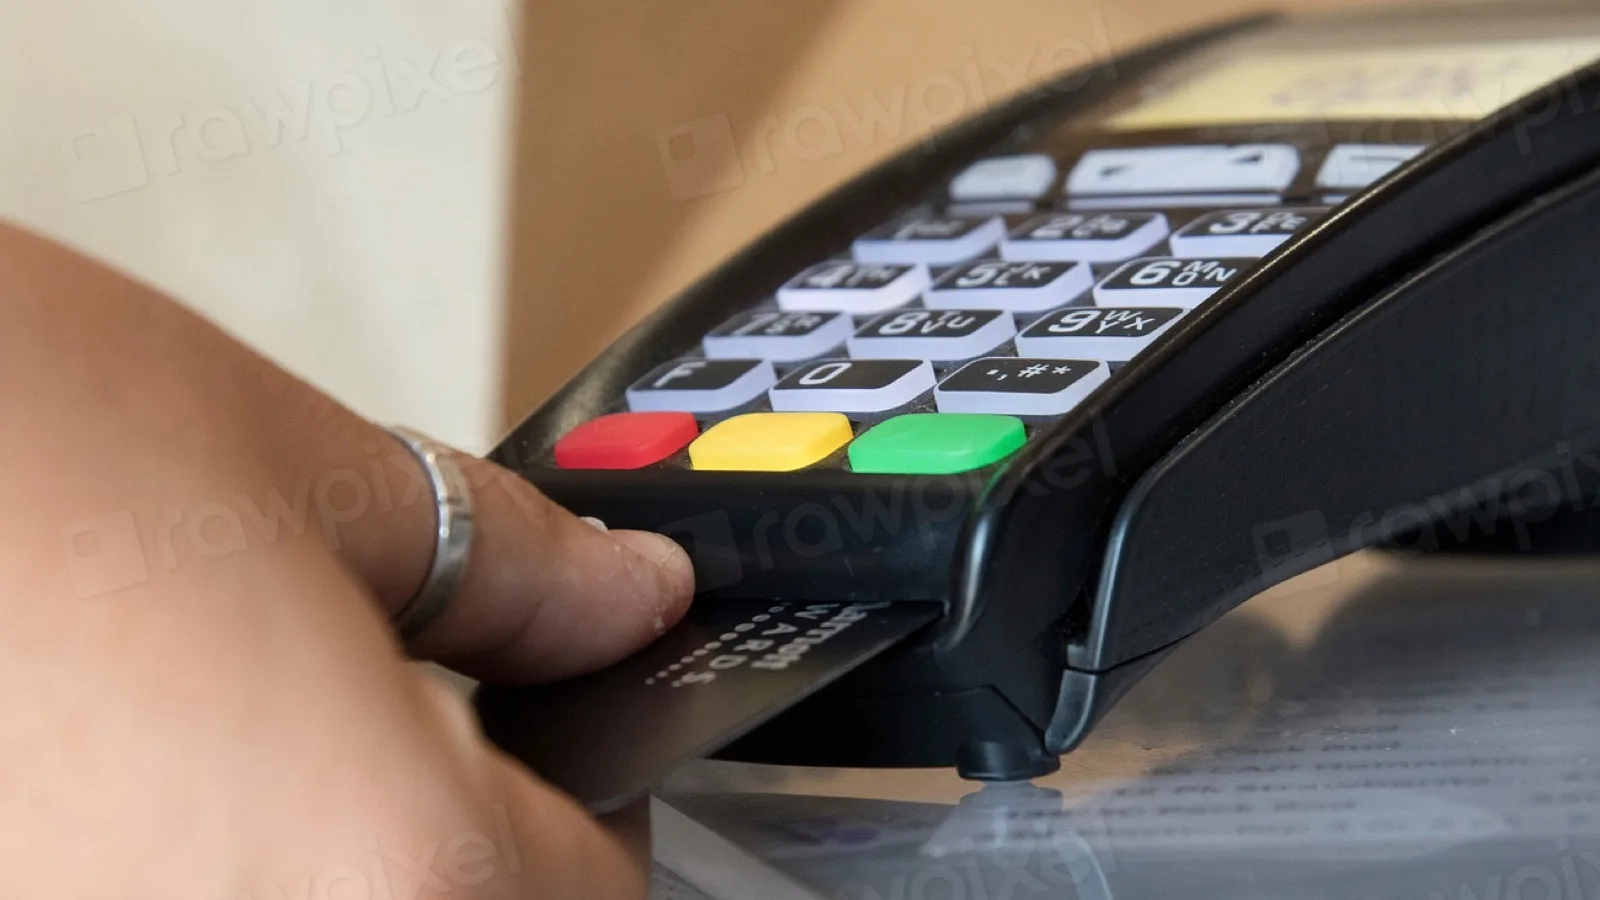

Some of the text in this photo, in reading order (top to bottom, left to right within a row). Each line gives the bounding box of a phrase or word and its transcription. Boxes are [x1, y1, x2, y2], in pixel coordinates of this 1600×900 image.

[1031, 214, 1084, 238] 2
[1208, 211, 1262, 233] 3
[955, 262, 1009, 287] 5
[1130, 261, 1181, 285] 6
[878, 311, 931, 335] 8
[1048, 310, 1101, 333] 9
[653, 361, 706, 388] F
